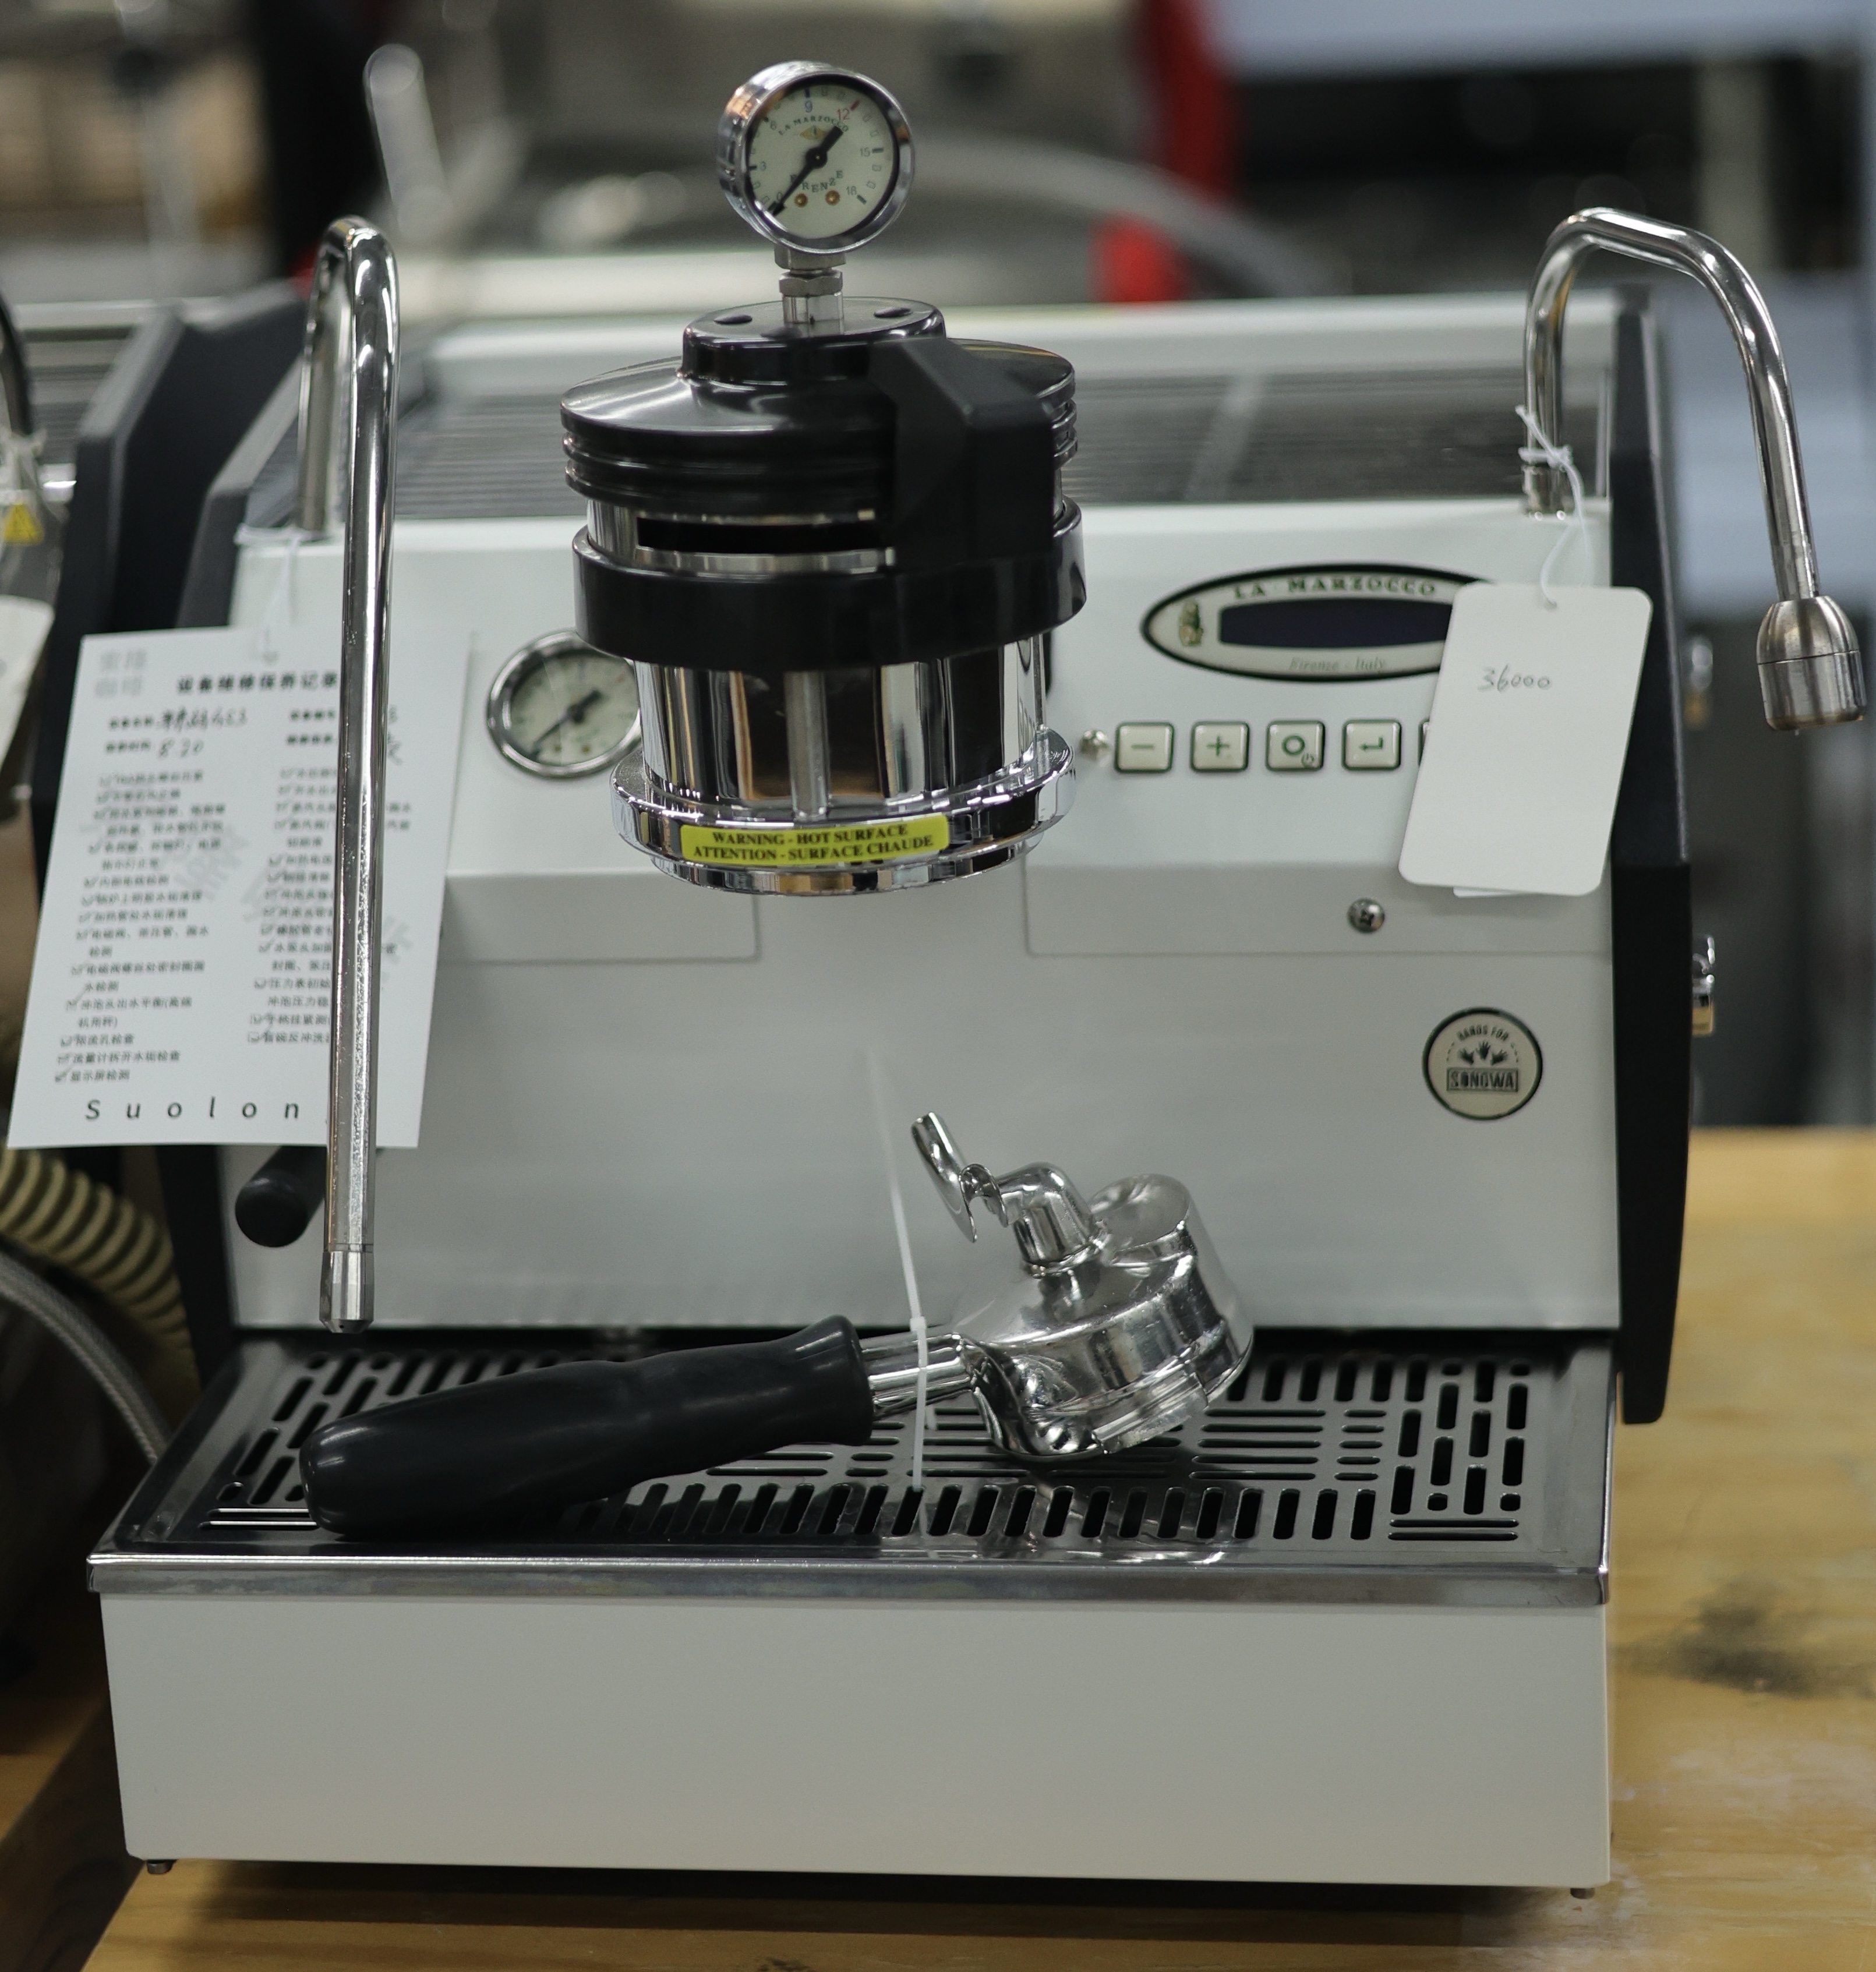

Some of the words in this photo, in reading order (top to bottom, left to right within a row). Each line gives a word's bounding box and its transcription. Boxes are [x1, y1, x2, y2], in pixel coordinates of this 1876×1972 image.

[805, 100, 813, 113] 9
[837, 108, 850, 121] 12
[860, 148, 870, 157] 15
[790, 170, 843, 193] FRENZE
[846, 185, 857, 196] 18
[1232, 585, 1266, 599] LA
[1288, 575, 1436, 596] MARZOCCO
[1355, 656, 1386, 674] Italy
[1477, 663, 1551, 694] 36000
[712, 831, 784, 846] WARNING
[797, 832, 829, 844] HOT
[833, 824, 908, 842] SURFACE
[693, 846, 777, 860] ATTENTION
[787, 843, 863, 860] SURFACE
[866, 835, 934, 854] CHAUDE
